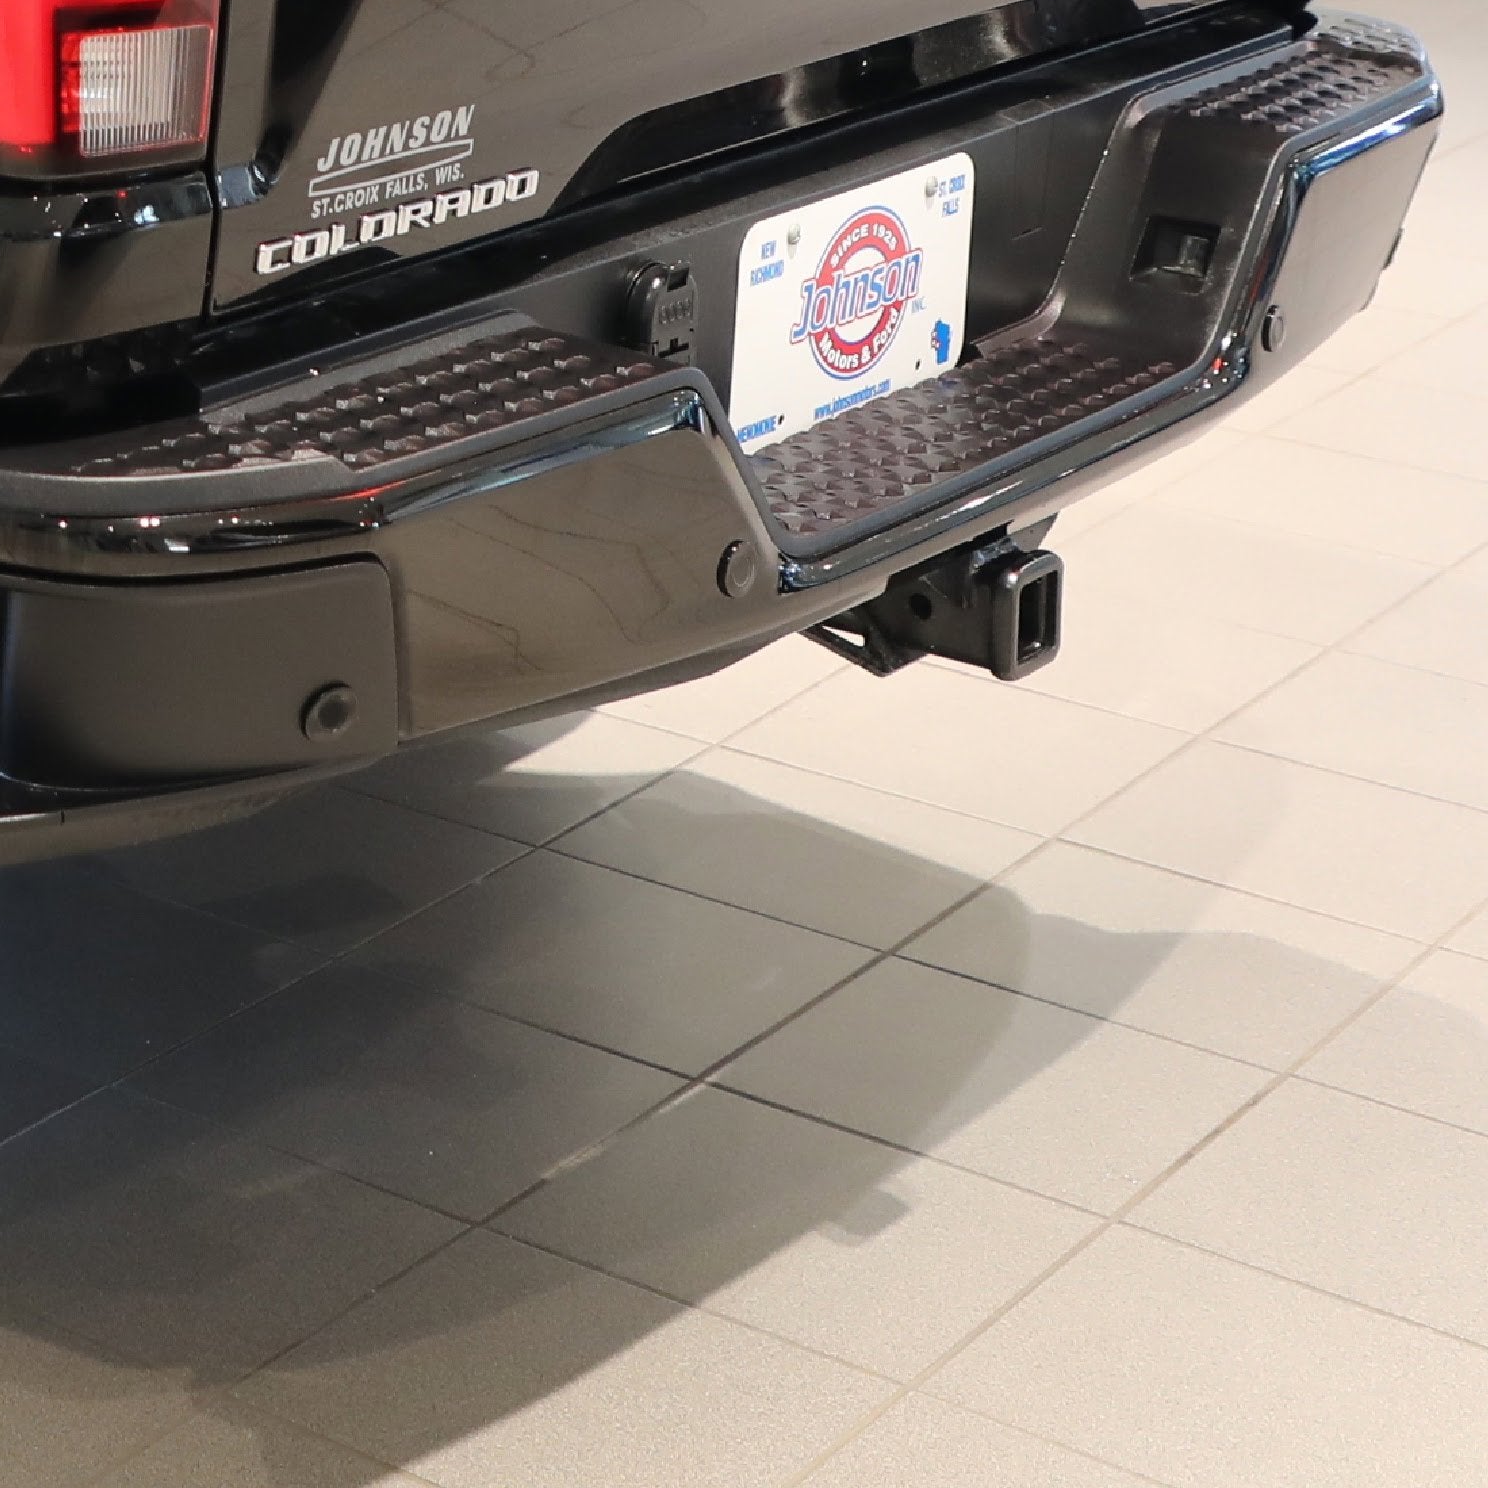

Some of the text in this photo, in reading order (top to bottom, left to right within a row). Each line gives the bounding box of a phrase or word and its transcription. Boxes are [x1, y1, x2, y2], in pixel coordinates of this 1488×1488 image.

[317, 104, 475, 173] JOHNSON
[255, 167, 540, 275] COLORADO
[830, 223, 869, 267] SINCE
[791, 249, 923, 343] Johnson
[819, 331, 859, 370] Motors
